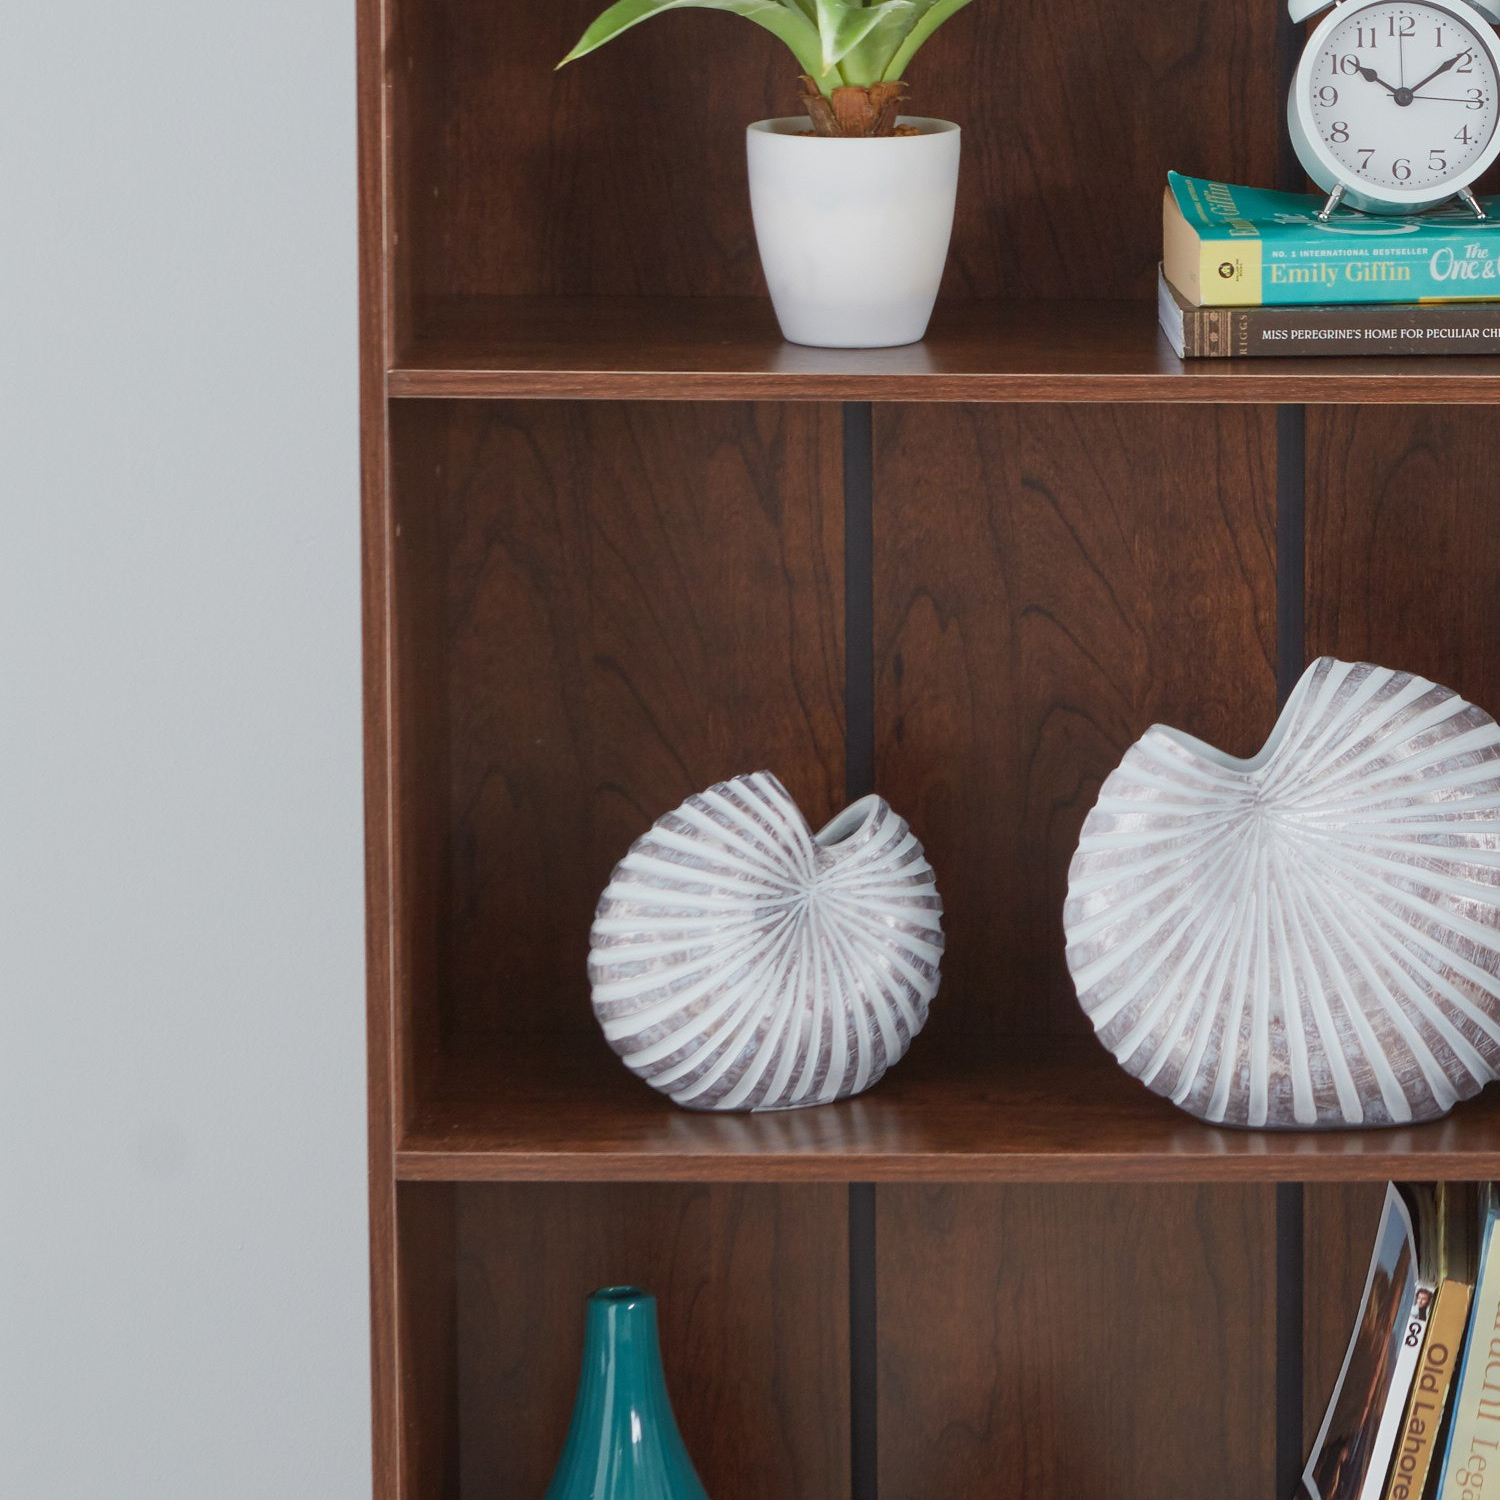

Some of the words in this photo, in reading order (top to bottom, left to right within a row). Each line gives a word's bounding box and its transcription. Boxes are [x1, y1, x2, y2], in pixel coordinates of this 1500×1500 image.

[1388, 15, 1416, 37] 12
[1357, 27, 1377, 48] 11
[1435, 27, 1442, 47] 1
[1331, 53, 1360, 75] 10
[1456, 53, 1473, 73] 2
[1319, 86, 1338, 107] 9
[1465, 89, 1484, 110] 3
[1330, 121, 1350, 143] 8
[1454, 124, 1472, 145] 4
[1357, 149, 1375, 169] 7
[1392, 159, 1411, 180] 6
[1428, 150, 1447, 170] 5
[1300, 248, 1370, 257] INTERNATIONAL
[1372, 247, 1429, 256] BESTSELLER
[1464, 242, 1489, 259] The
[1270, 262, 1339, 287] Emily
[1345, 261, 1411, 282] Giffin
[1429, 247, 1480, 281] One
[1482, 260, 1496, 279] &
[1239, 314, 1248, 355] RIGGS
[1262, 329, 1288, 340] MISS
[1291, 329, 1362, 340] PEREGRINE'S
[1364, 328, 1398, 339] HOME
[1400, 328, 1424, 339] FOR
[1426, 328, 1480, 339] PECULIAR
[1405, 1322, 1422, 1347] GQ
[1419, 1343, 1448, 1394] Old
[1393, 1401, 1435, 1500] Lahore
